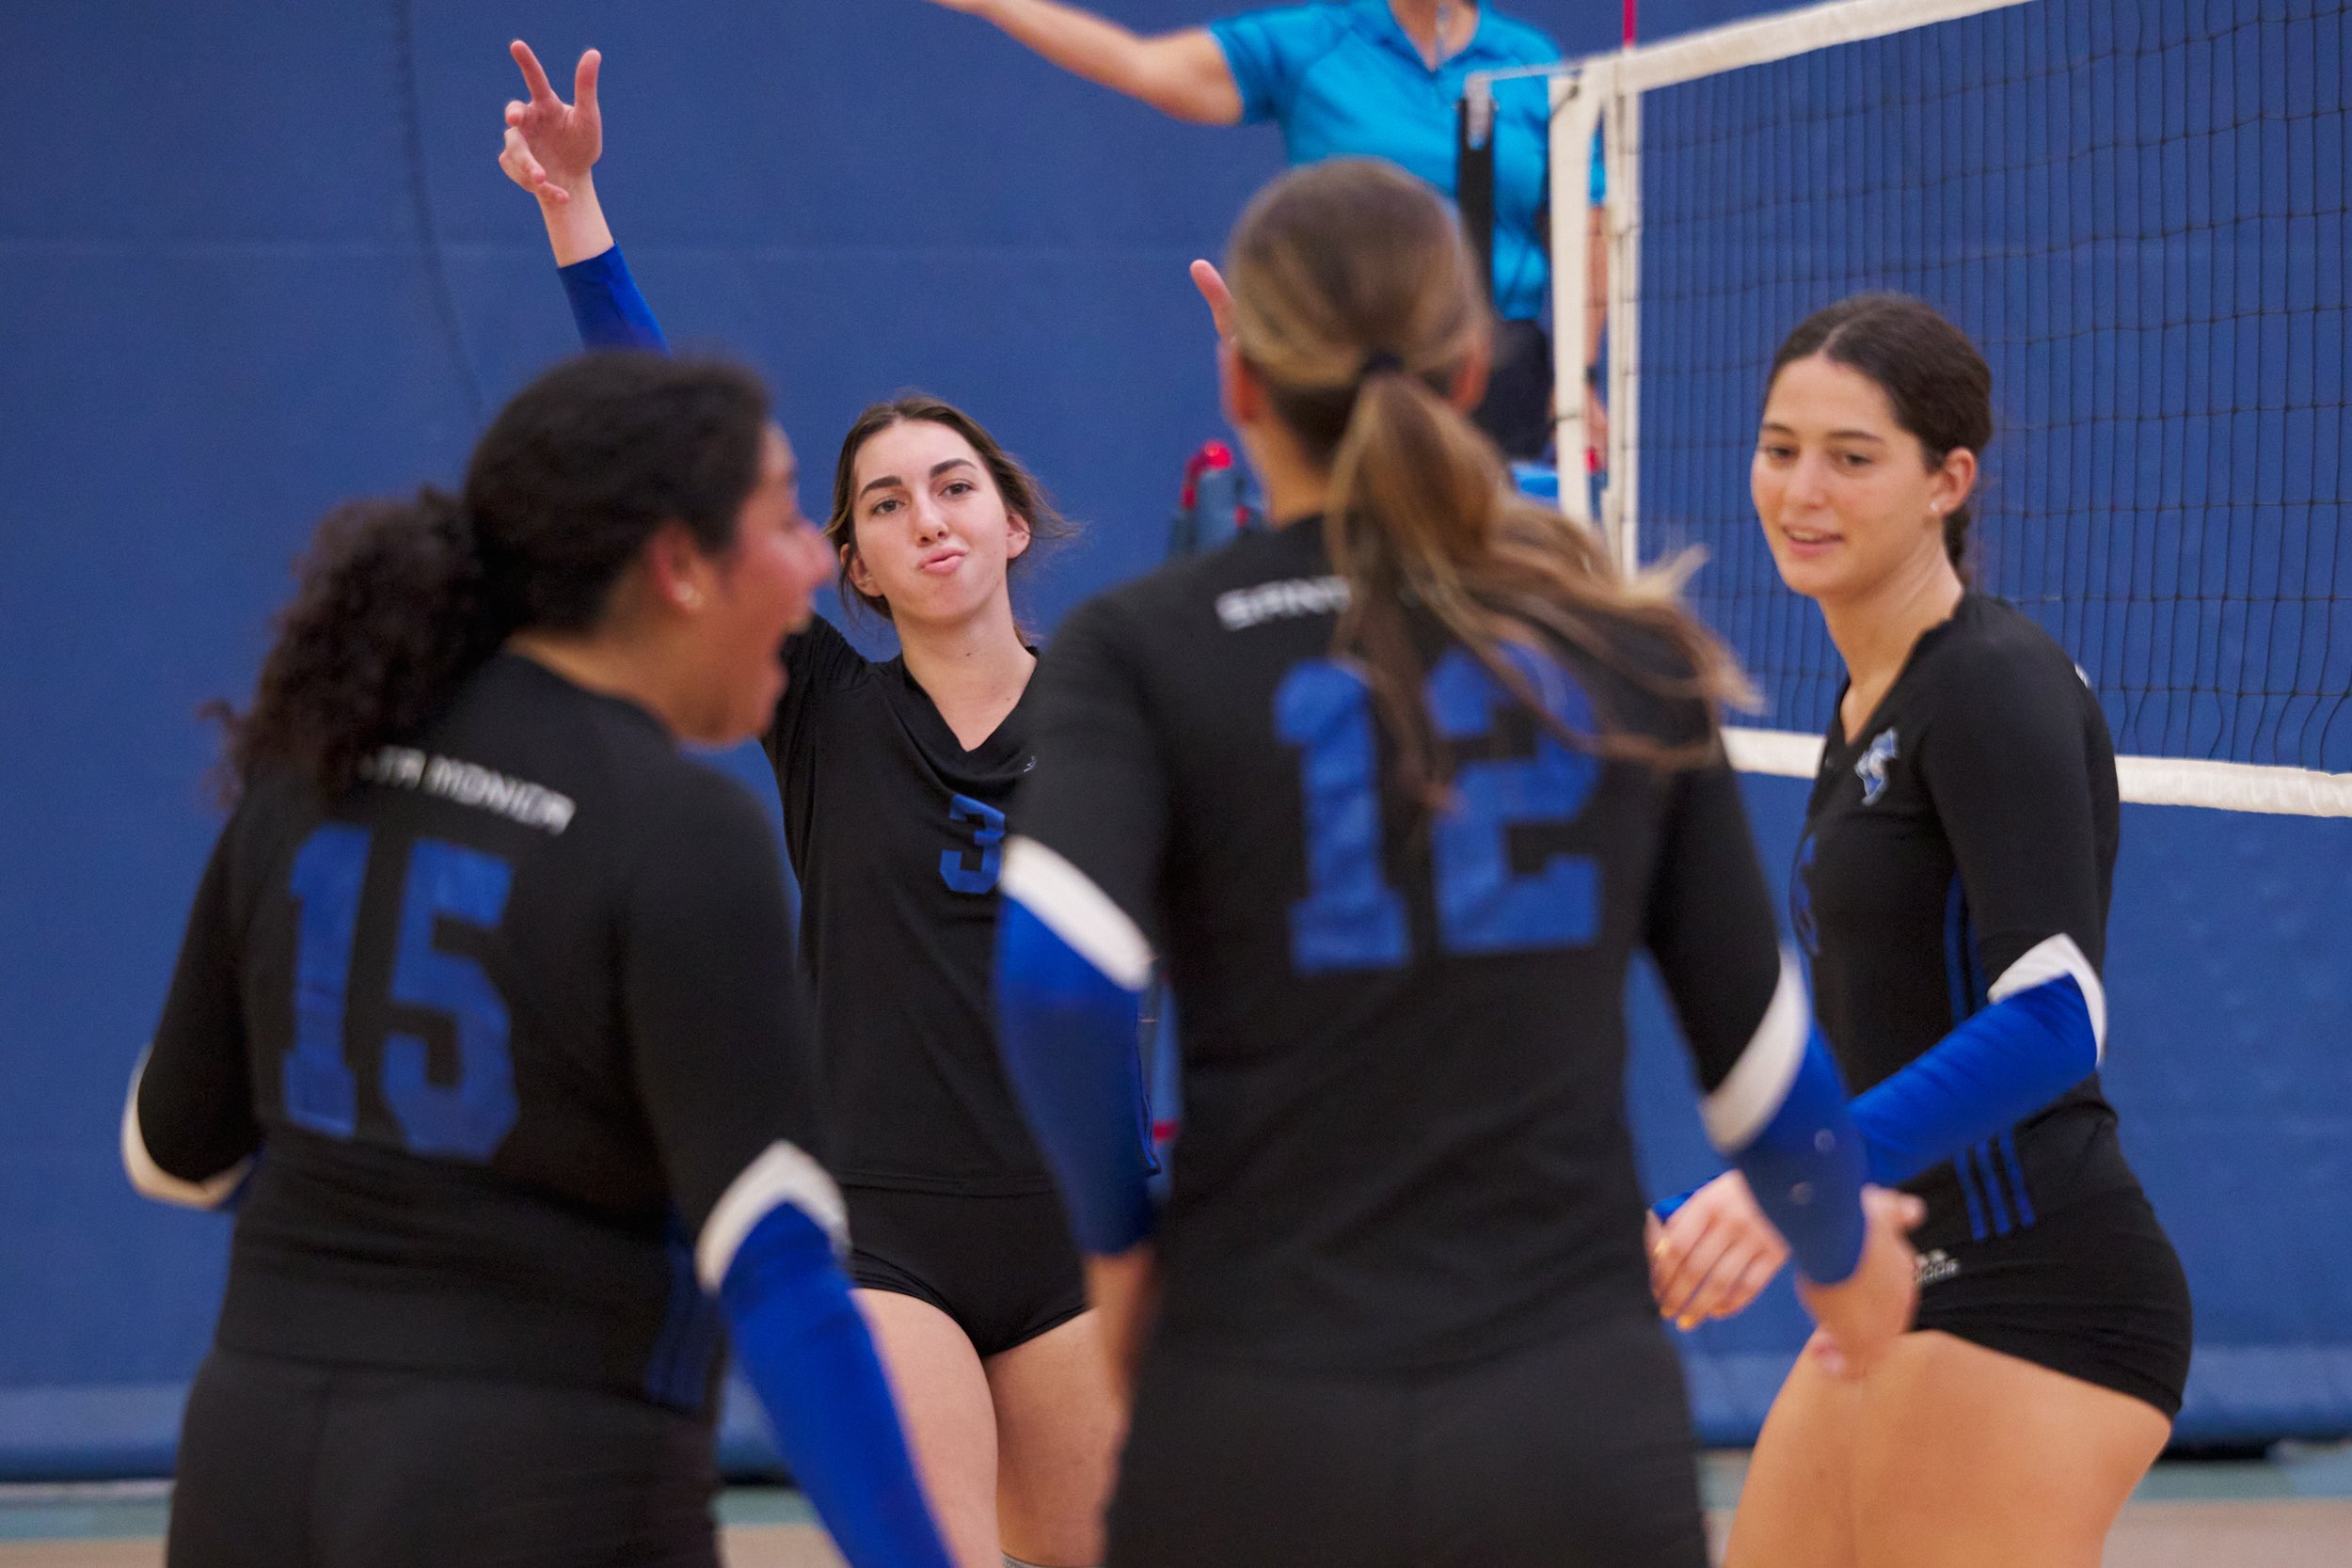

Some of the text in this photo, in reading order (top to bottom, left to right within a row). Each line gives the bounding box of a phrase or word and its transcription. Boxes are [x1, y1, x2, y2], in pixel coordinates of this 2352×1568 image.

[1215, 575, 1352, 631] SANT
[422, 754, 577, 836] MONICA
[939, 793, 1006, 894] 3
[1273, 640, 1601, 974] 12
[281, 820, 520, 1164] 15
